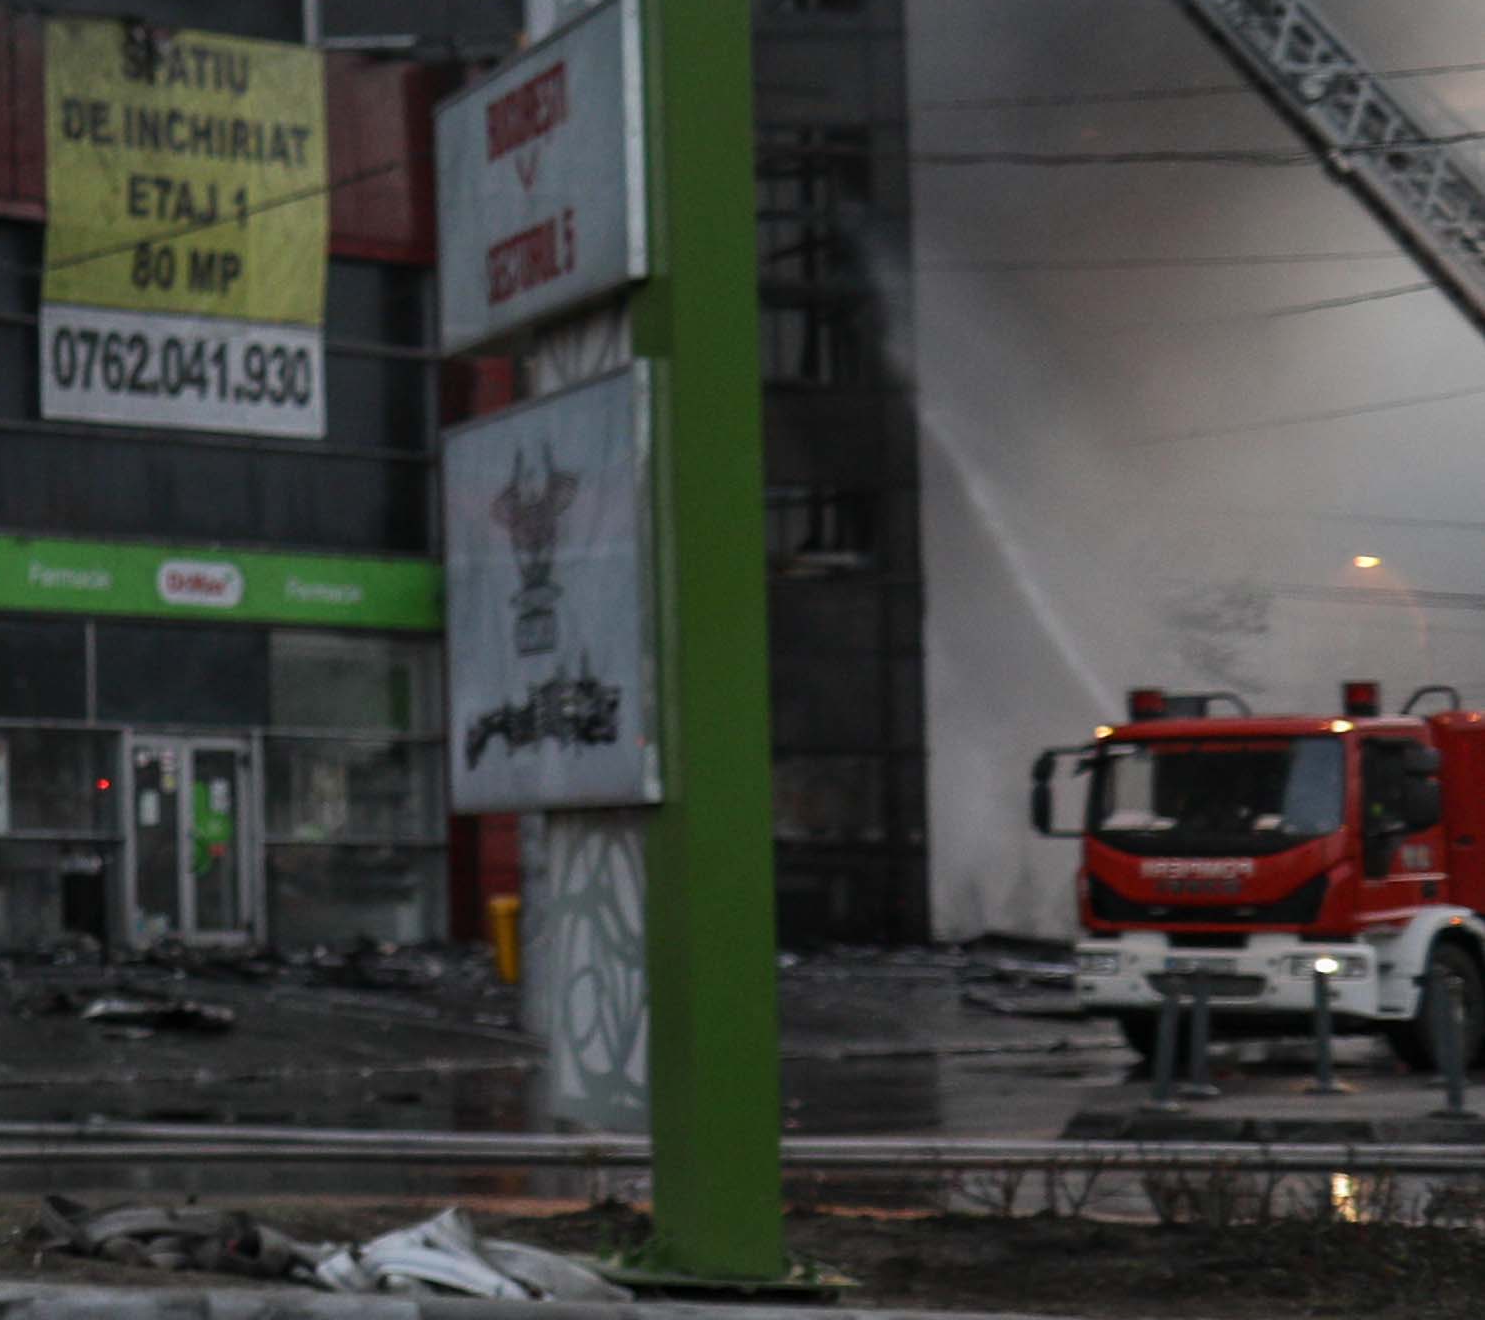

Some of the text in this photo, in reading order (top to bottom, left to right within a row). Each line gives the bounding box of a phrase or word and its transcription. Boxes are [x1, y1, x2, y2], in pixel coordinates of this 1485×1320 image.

[60, 99, 313, 169] DE INCHIRIAT
[128, 173, 218, 223] ETAJ
[188, 247, 243, 295] MP
[52, 328, 313, 408] 0762.041.930
